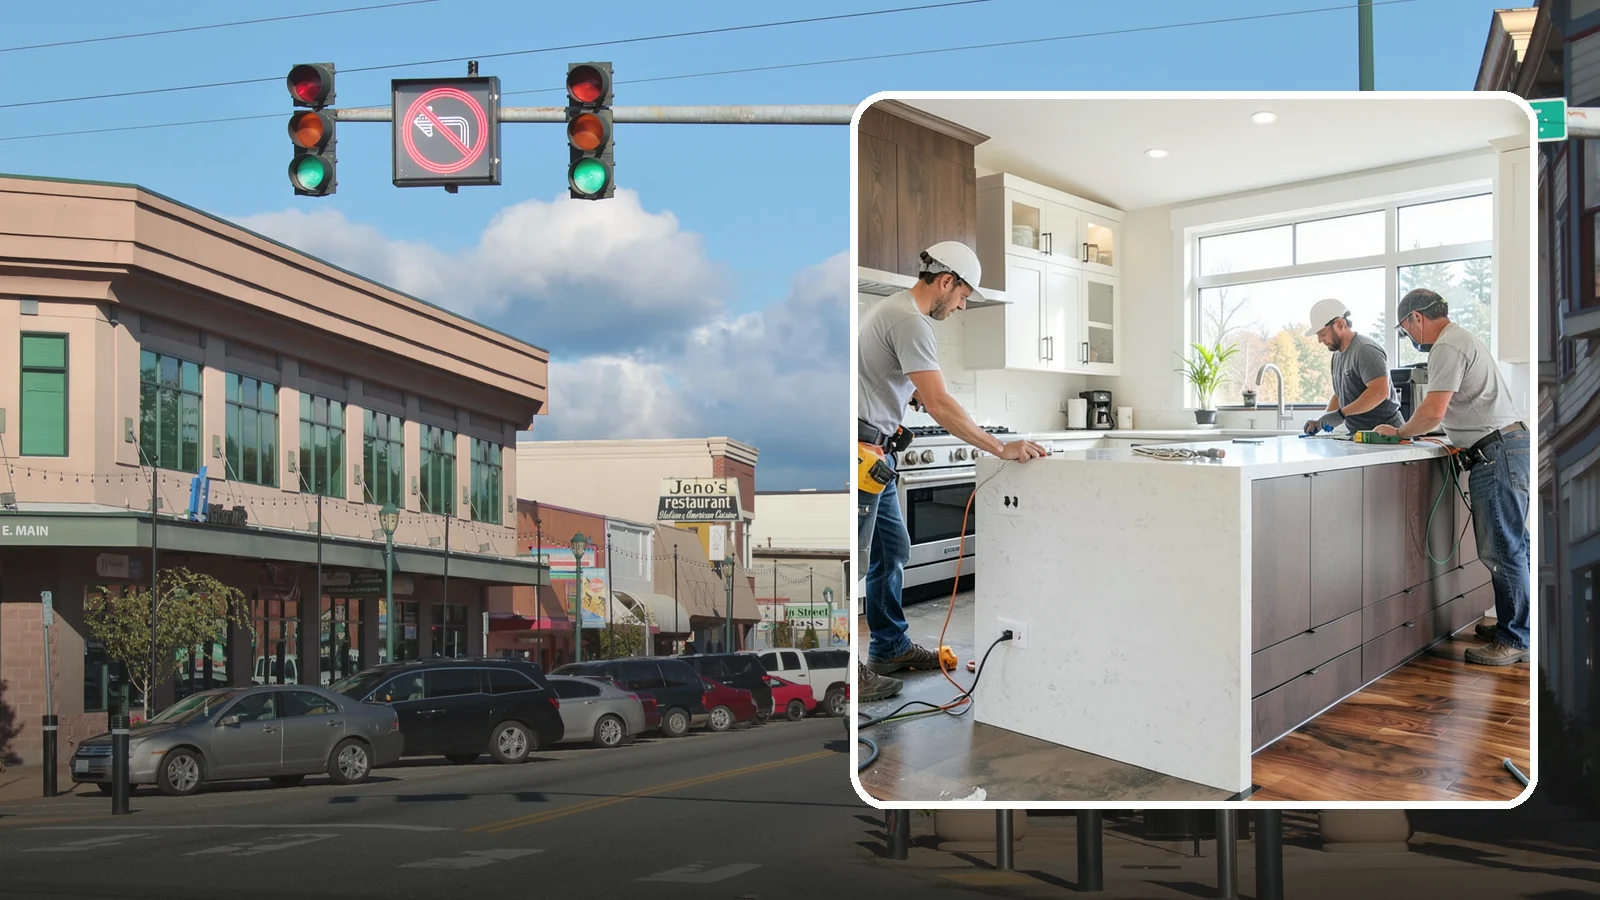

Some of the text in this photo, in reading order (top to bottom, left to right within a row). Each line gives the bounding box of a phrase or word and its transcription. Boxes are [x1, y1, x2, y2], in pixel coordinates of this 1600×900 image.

[669, 479, 728, 495] Jeno's
[664, 496, 731, 509] restaurant
[658, 510, 682, 520] Italian
[686, 510, 714, 519] American
[714, 510, 738, 519] Cuisine
[2, 525, 49, 536] E. MAIN
[785, 607, 795, 617] in
[797, 607, 828, 617] Street
